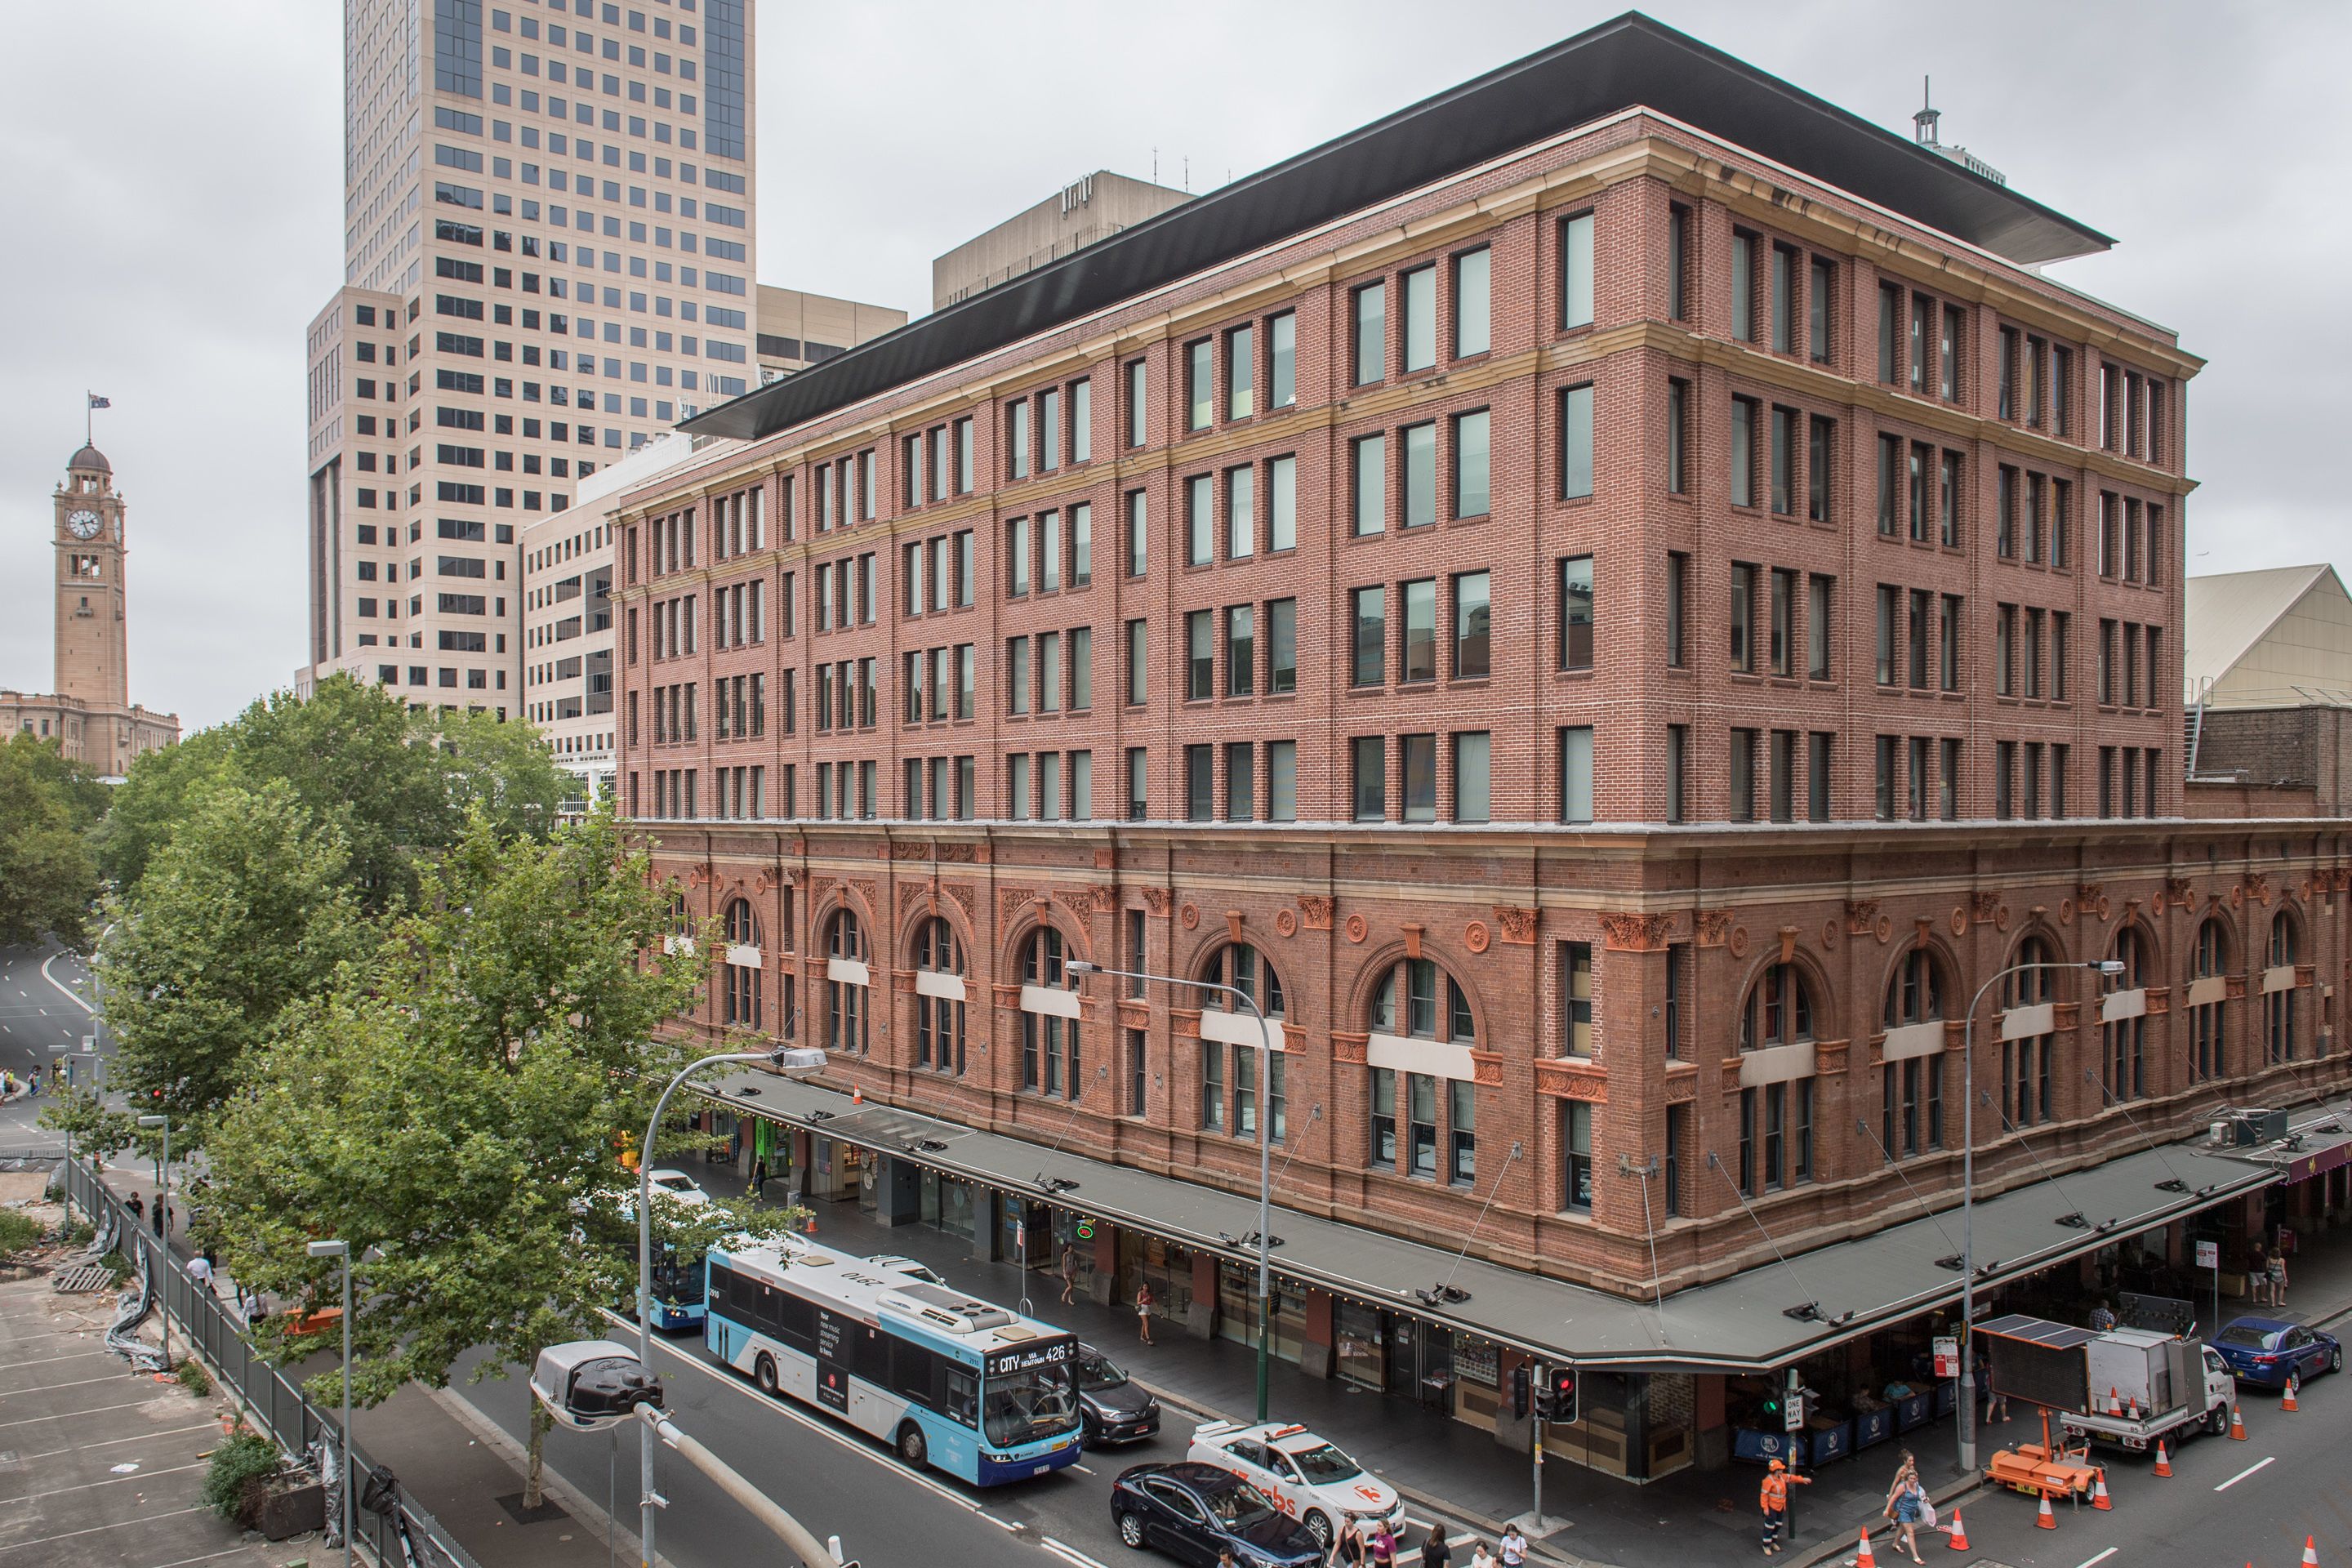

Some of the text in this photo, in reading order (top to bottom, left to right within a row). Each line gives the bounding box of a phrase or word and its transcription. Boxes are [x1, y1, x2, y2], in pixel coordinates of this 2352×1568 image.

[840, 1272, 885, 1287] 2910
[709, 1289, 719, 1299] 2910
[820, 1311, 830, 1321] Your
[828, 1324, 840, 1334] music
[820, 1330, 840, 1344] streaming
[820, 1338, 834, 1349] service
[1045, 1345, 1065, 1362] 426
[969, 1357, 979, 1366] 2910
[1000, 1354, 1020, 1373] CITY
[1021, 1356, 1045, 1368] NEWTOWN
[1788, 1399, 1800, 1410] ONE
[1787, 1410, 1800, 1419] WAY
